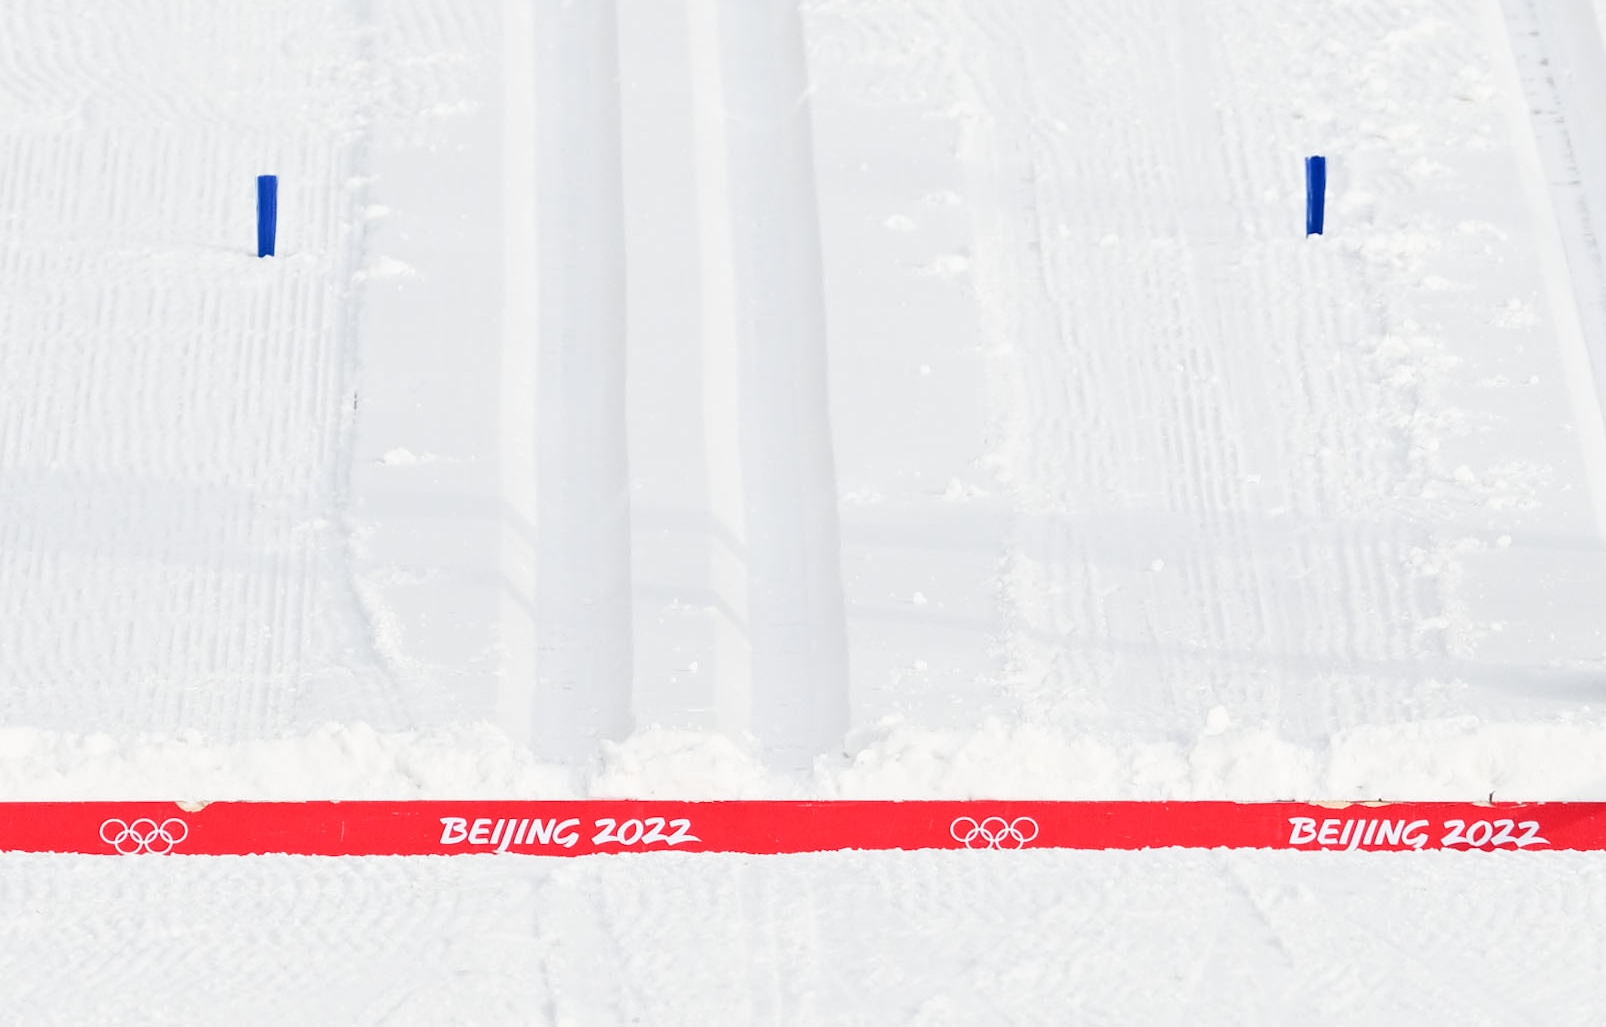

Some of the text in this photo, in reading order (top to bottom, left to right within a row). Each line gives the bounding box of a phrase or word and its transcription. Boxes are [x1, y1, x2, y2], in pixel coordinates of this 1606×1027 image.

[439, 816, 703, 853] BEIJING 2022
[1288, 816, 1551, 851] BEIJING 2022
